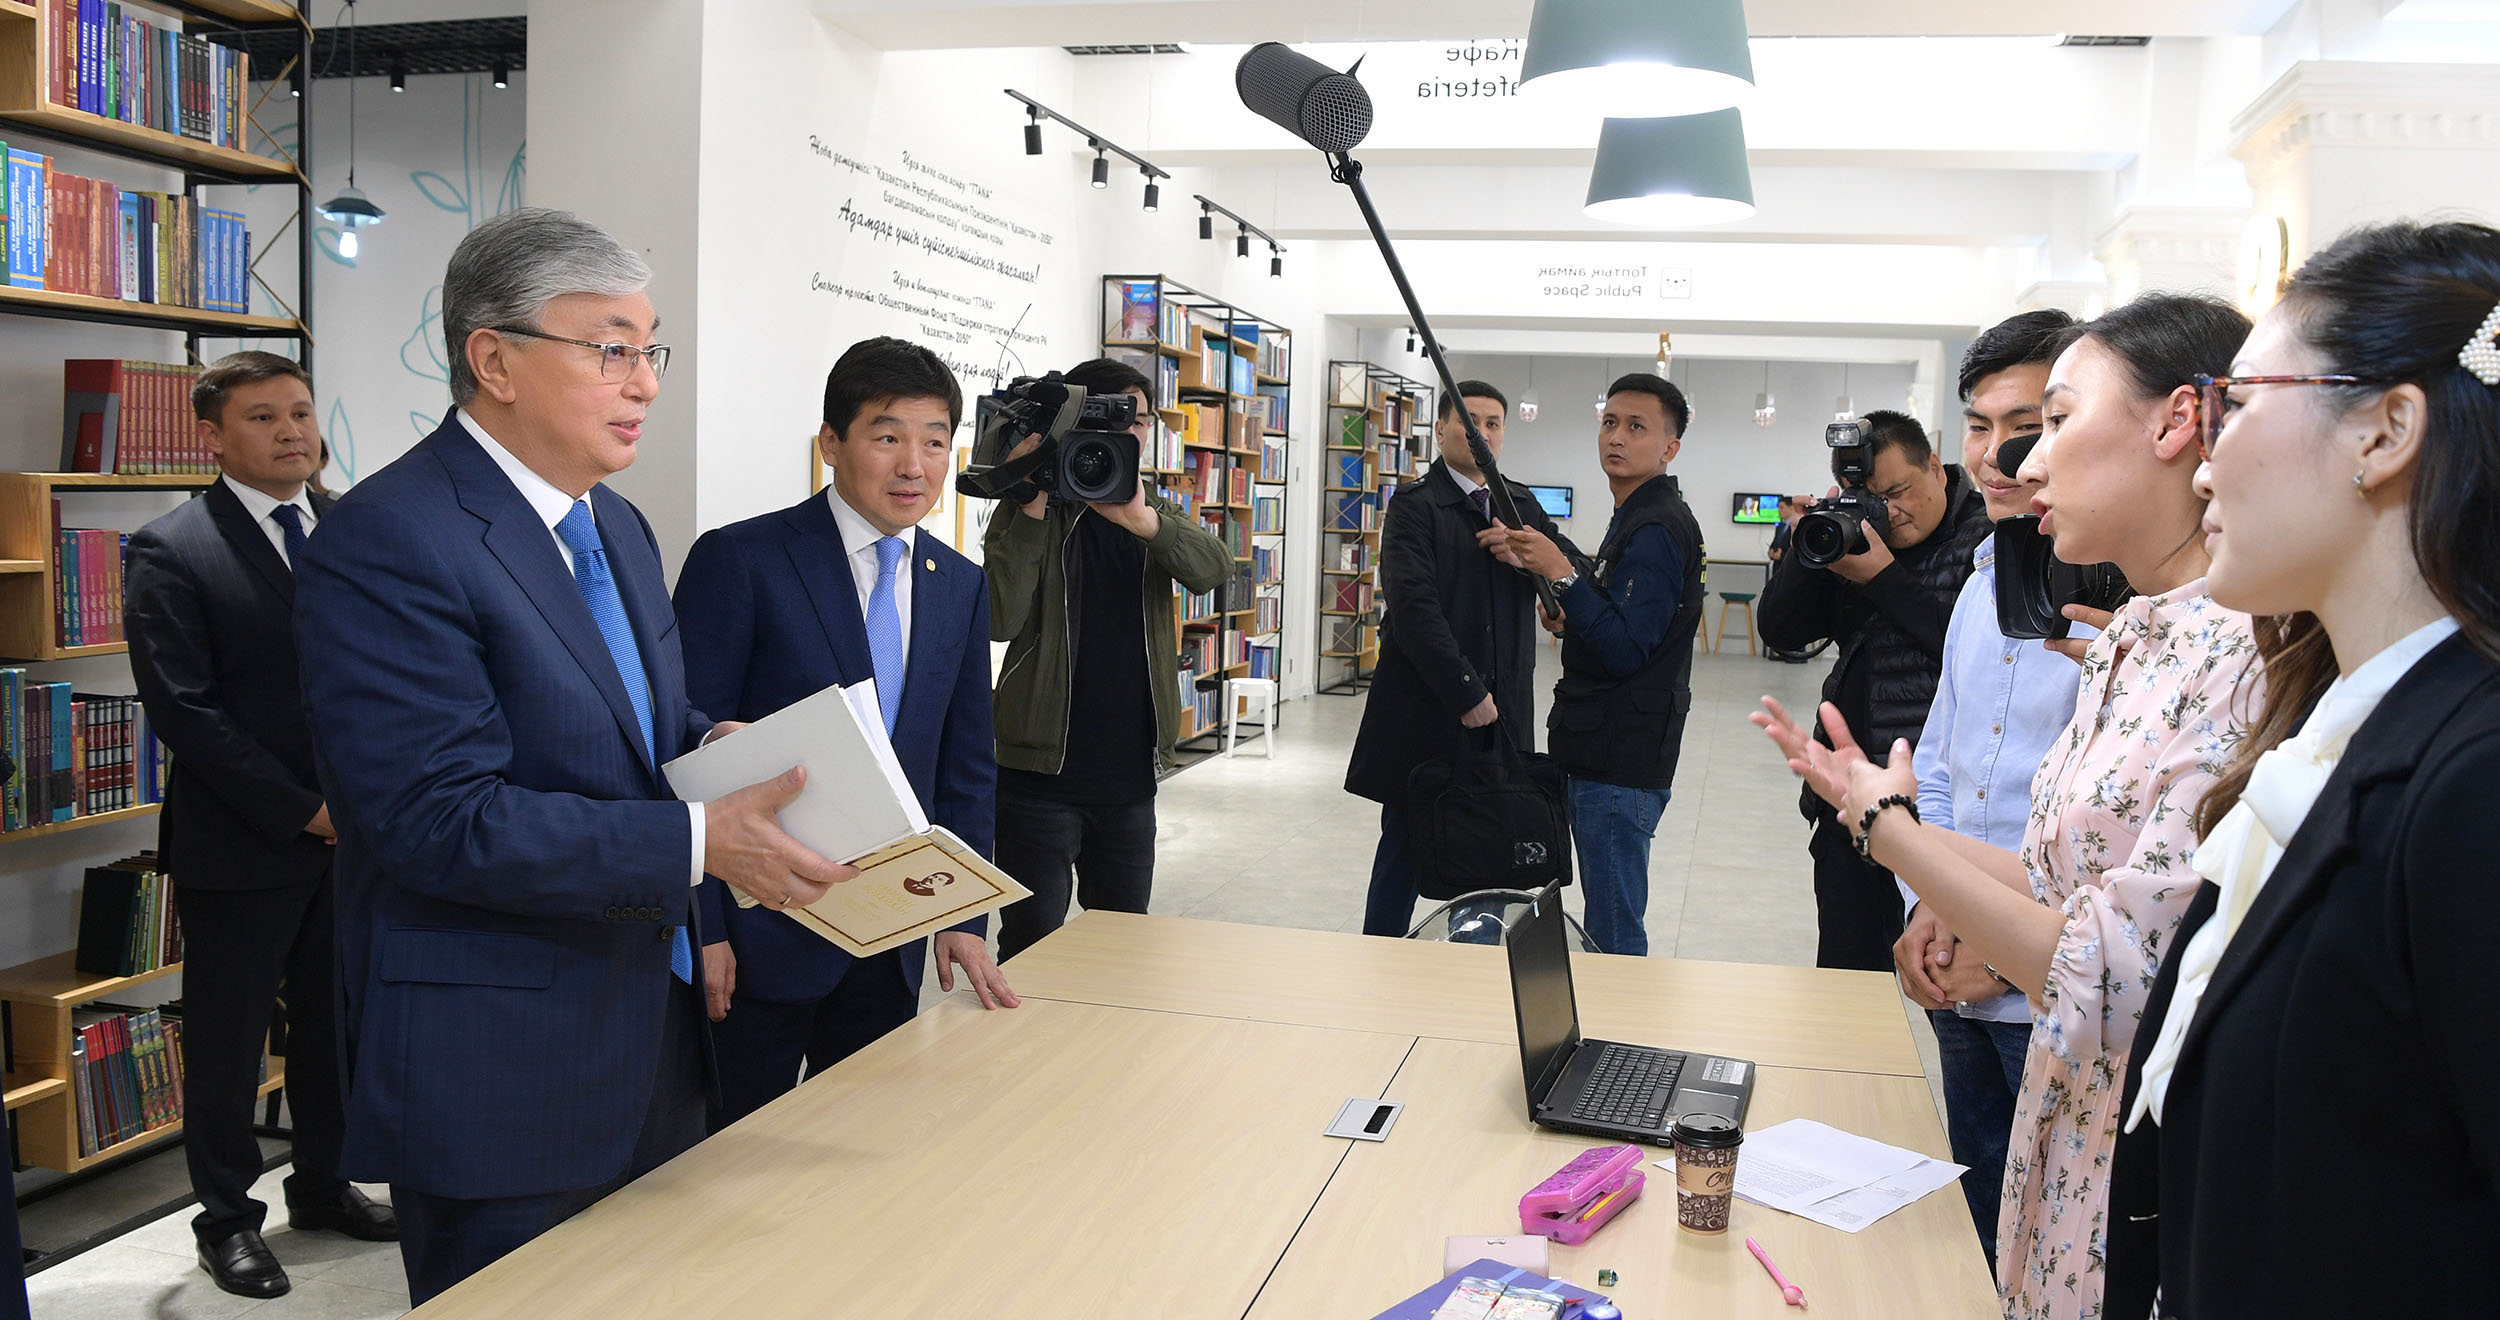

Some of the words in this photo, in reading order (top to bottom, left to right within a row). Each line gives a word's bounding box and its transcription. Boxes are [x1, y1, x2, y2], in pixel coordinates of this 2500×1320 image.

[838, 197, 892, 242] Адамдар
[811, 272, 843, 299] Спонсор
[879, 292, 930, 317] Общественный
[931, 306, 948, 323] Фонд
